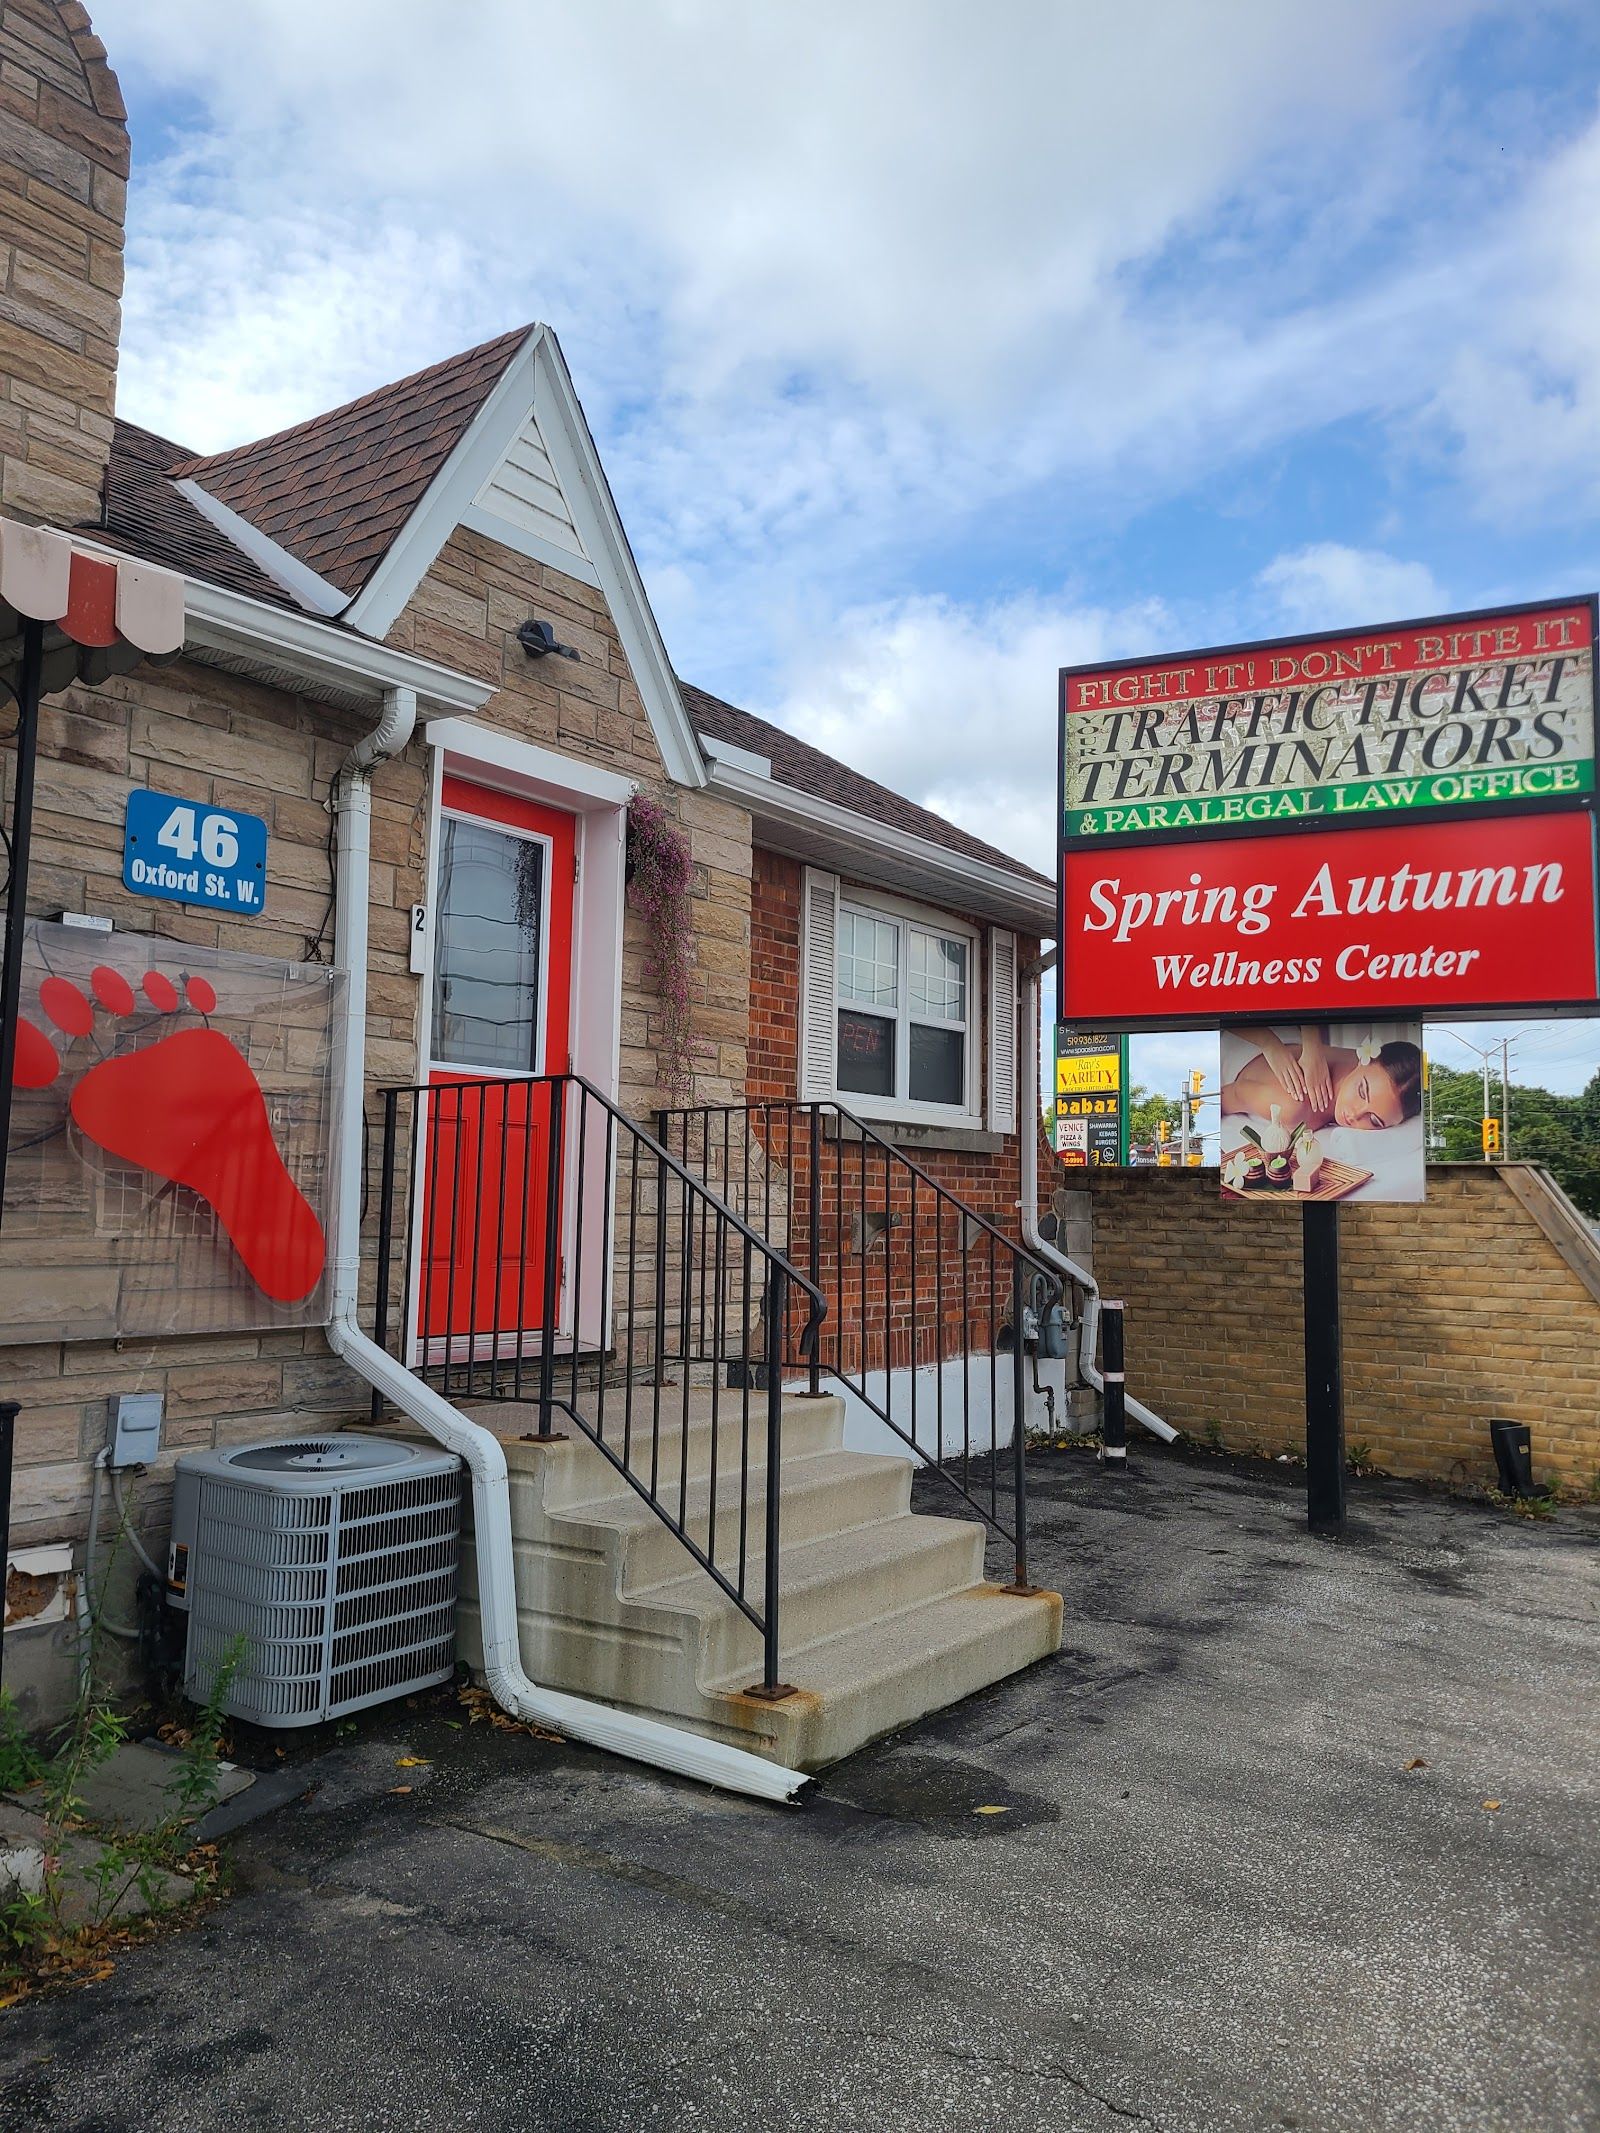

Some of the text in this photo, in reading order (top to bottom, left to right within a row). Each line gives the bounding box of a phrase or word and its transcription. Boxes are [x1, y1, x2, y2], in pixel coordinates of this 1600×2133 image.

[1077, 617, 1581, 708] FIGHT IT! DON'T BITE IT
[1102, 654, 1580, 754] TRAFFIC TICKET
[1077, 715, 1099, 756] YOUR
[1078, 710, 1567, 804] TERMINATORS
[1079, 763, 1580, 835] & PARALEGAL LAW OFFICE
[156, 805, 240, 869] 46
[131, 858, 260, 905] Oxford St. W.
[1083, 862, 1565, 943] Spring Autumn
[415, 908, 425, 932] 2
[1152, 944, 1480, 990] Wellness Center
[840, 1023, 880, 1054] PEN
[1060, 1069, 1117, 1086] VARIETY
[1076, 1058, 1100, 1072] Ray's
[1057, 1097, 1117, 1115] babaz
[1059, 1123, 1084, 1132] VENICE
[1089, 1122, 1118, 1130] SHAWARMA
